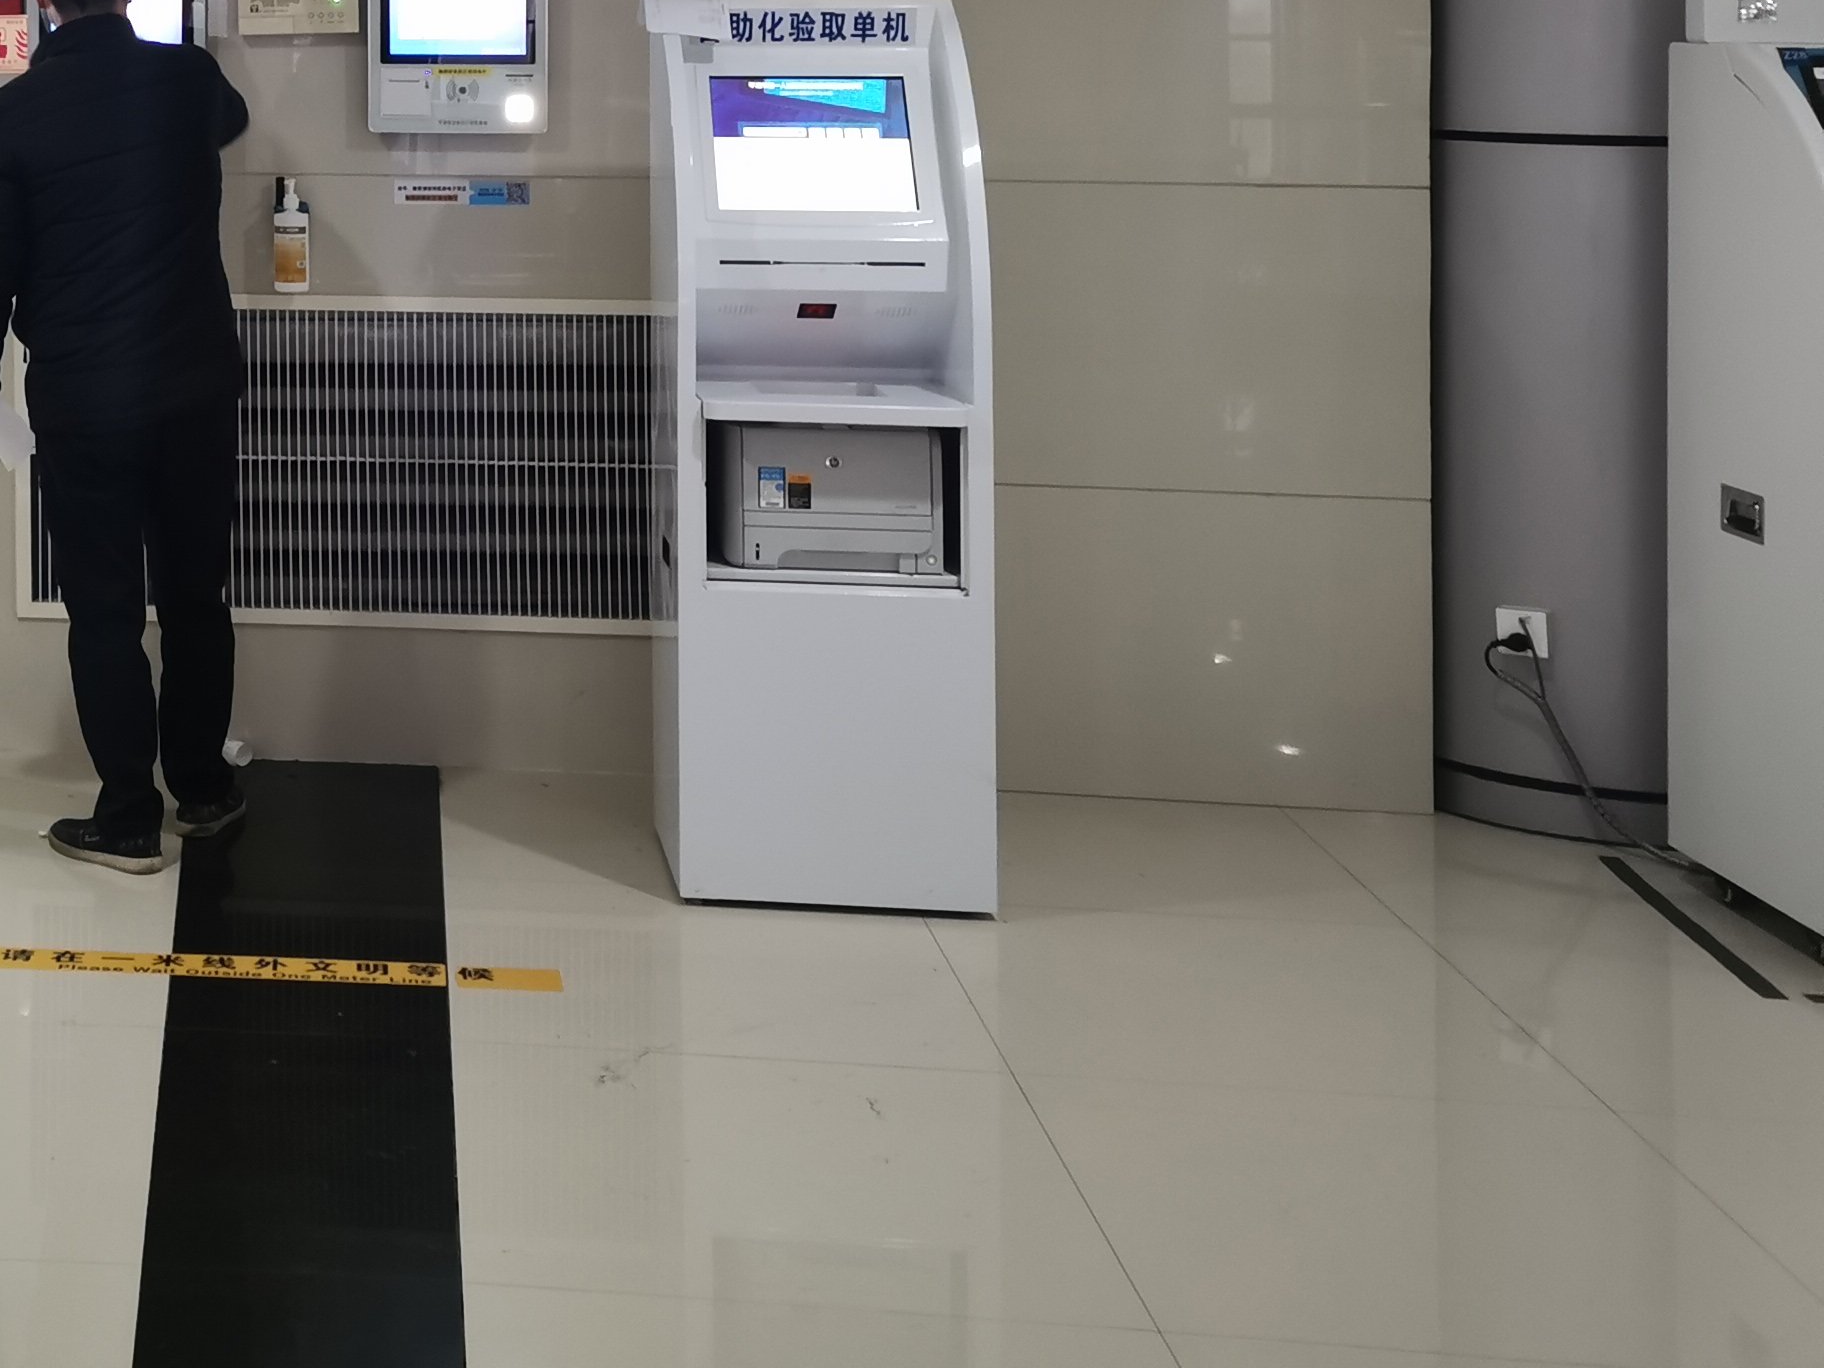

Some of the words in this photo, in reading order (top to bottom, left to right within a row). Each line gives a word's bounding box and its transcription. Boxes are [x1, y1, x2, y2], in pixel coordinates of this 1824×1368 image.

[699, 11, 910, 44] 助化验取单机
[2, 948, 493, 982] 请在一米线外文明等候
[57, 963, 124, 972] Please
[133, 966, 176, 975] Wait
[186, 968, 263, 978] Outside
